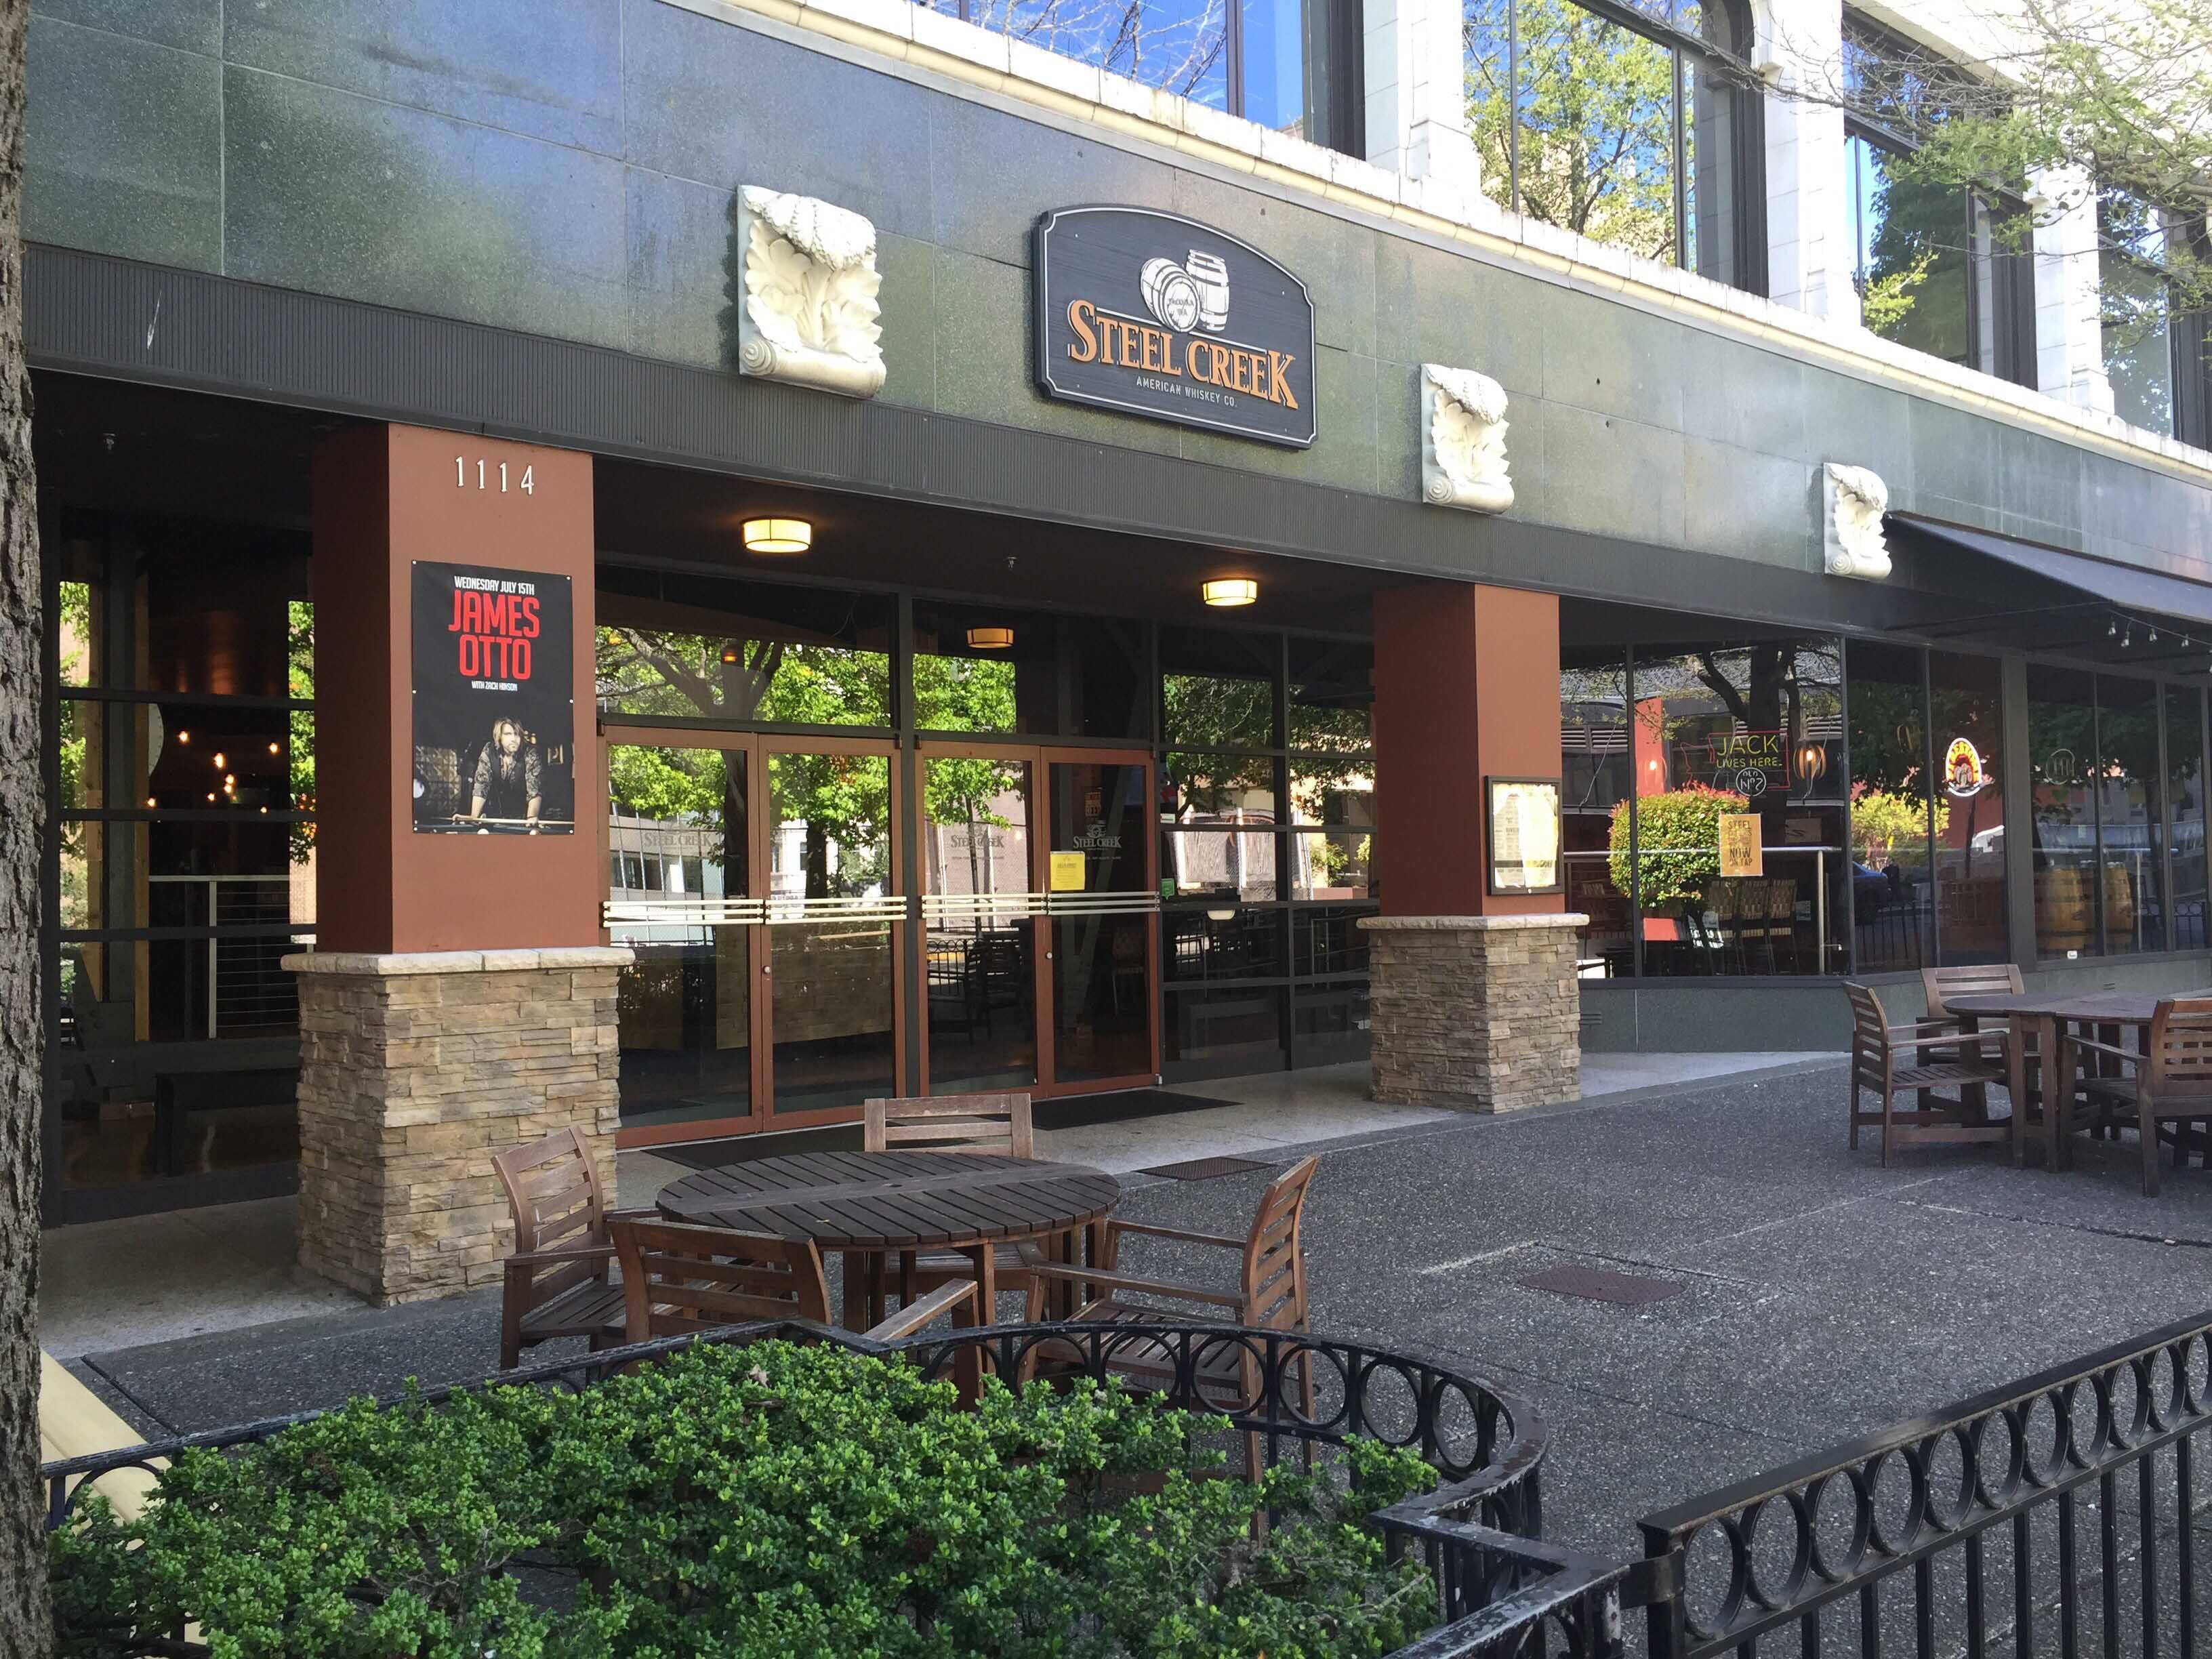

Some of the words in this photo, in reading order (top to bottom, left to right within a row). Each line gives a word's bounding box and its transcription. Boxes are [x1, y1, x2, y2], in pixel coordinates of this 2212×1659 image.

[1067, 299, 1182, 377] STEEL
[1186, 340, 1299, 409] CREEK
[1136, 376, 1181, 396] AMERICAN
[1185, 386, 1221, 404] WHISKEY
[1224, 395, 1237, 407] CO.
[455, 456, 535, 495] 1114
[454, 576, 499, 592] WEDNESDAY
[500, 581, 516, 594] JULY
[518, 583, 535, 595] 15TH
[448, 590, 540, 638] JAMES
[459, 634, 531, 680] OTTO
[472, 680, 485, 689] WITH
[485, 681, 498, 690] ZACH
[1717, 735, 1778, 756] JACK
[1717, 758, 1746, 768] LIVES
[643, 832, 677, 846] STEEL
[678, 833, 712, 846] CREEK
[977, 836, 1004, 848] CEK
[1073, 836, 1097, 848] STEEL
[1097, 836, 1122, 848] CREEK
[1729, 847, 1752, 858] NOW
[1740, 857, 1753, 867] TAP
